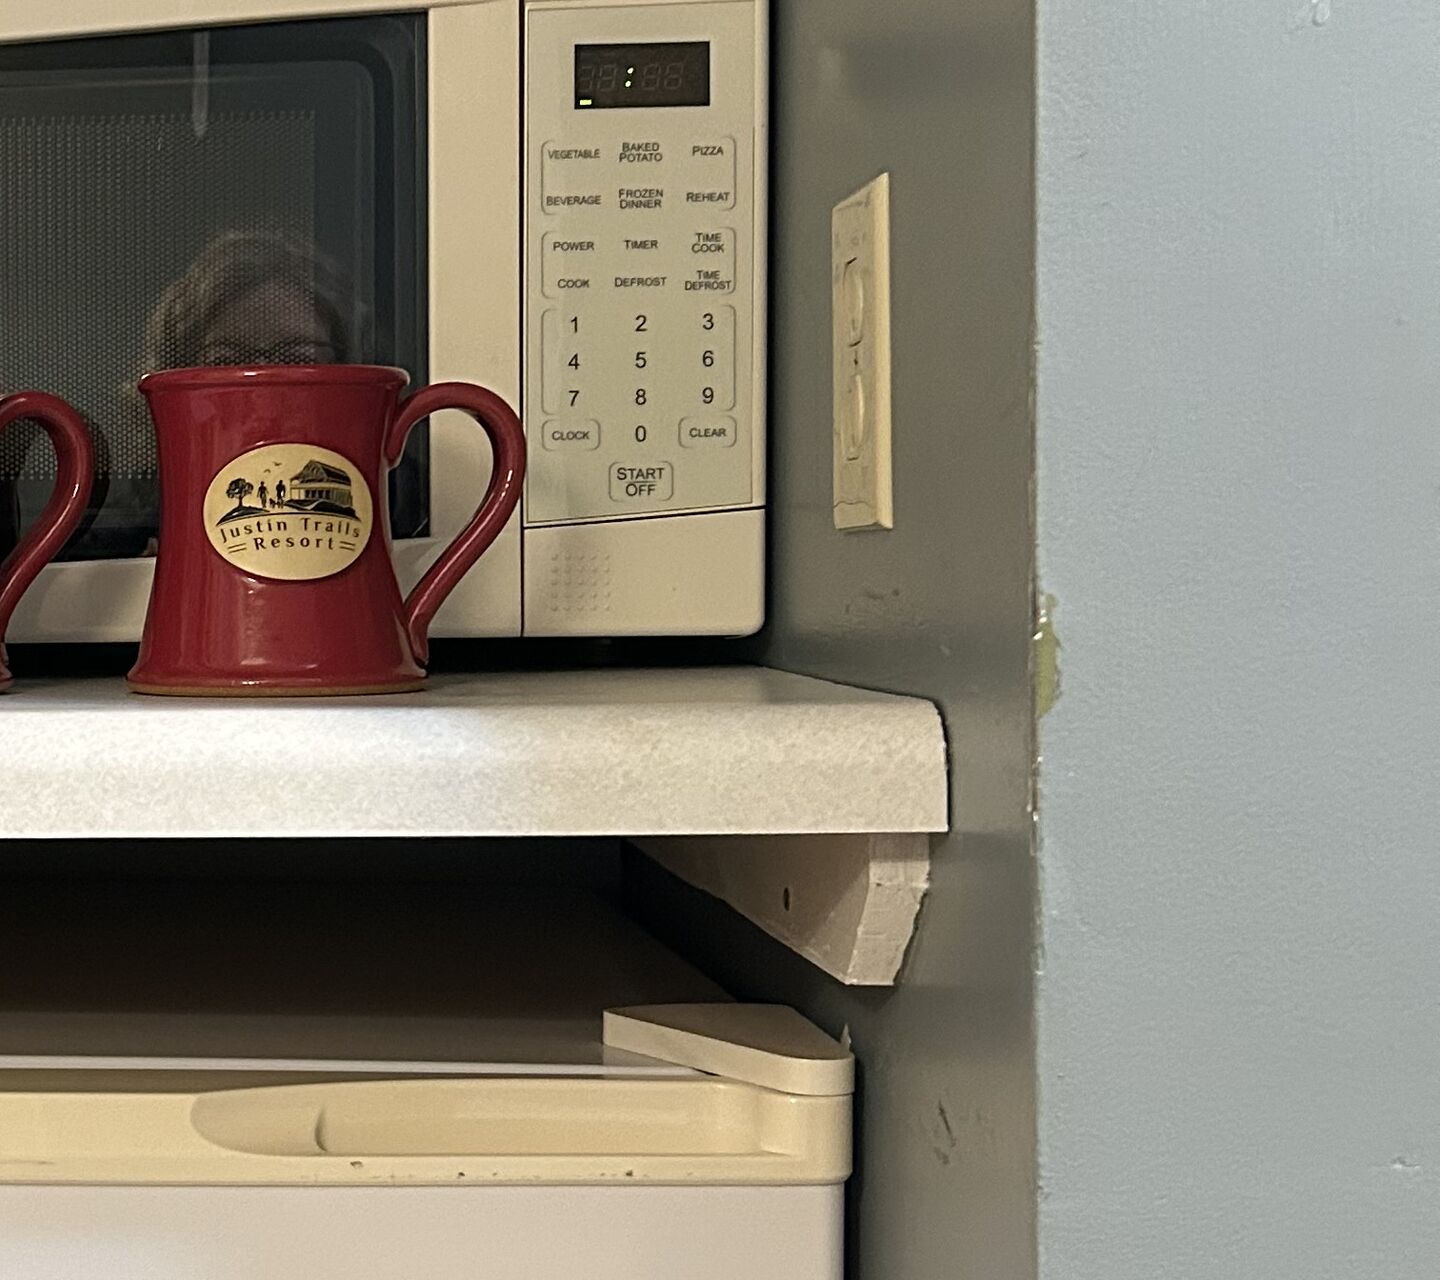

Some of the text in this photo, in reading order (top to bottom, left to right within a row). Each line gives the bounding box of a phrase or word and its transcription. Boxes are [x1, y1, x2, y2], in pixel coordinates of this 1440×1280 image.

[622, 142, 660, 152] BAKED
[692, 145, 723, 156] PIZZA
[548, 149, 600, 159] VEGETABLE
[619, 152, 662, 162] POTATO
[619, 189, 663, 199] FROZEN
[686, 192, 730, 202] REHEAT
[546, 195, 601, 206] BEVERAGE
[619, 199, 662, 209] DINNER
[696, 233, 721, 243] TIME
[553, 242, 594, 251] POWER
[624, 240, 658, 249] TIMER
[692, 243, 724, 253] COOK
[696, 270, 720, 280] TIME
[557, 279, 589, 288] COOK
[614, 277, 667, 287] DEFROST
[684, 280, 731, 290] DEFROST
[570, 317, 578, 333] 1
[635, 315, 647, 332] 2
[702, 313, 714, 330] 3
[568, 354, 580, 370] 4
[635, 352, 647, 368] 5
[702, 350, 714, 367] 6
[568, 390, 580, 406] 7
[635, 389, 647, 405] 8
[702, 387, 714, 404] 9
[552, 431, 590, 441] CLOCK
[635, 426, 647, 442] 0
[689, 428, 727, 438] CLEAR
[617, 468, 664, 481] START
[625, 484, 656, 496] OFF
[220, 517, 360, 544] Justin Trails
[253, 536, 334, 551] Resort
